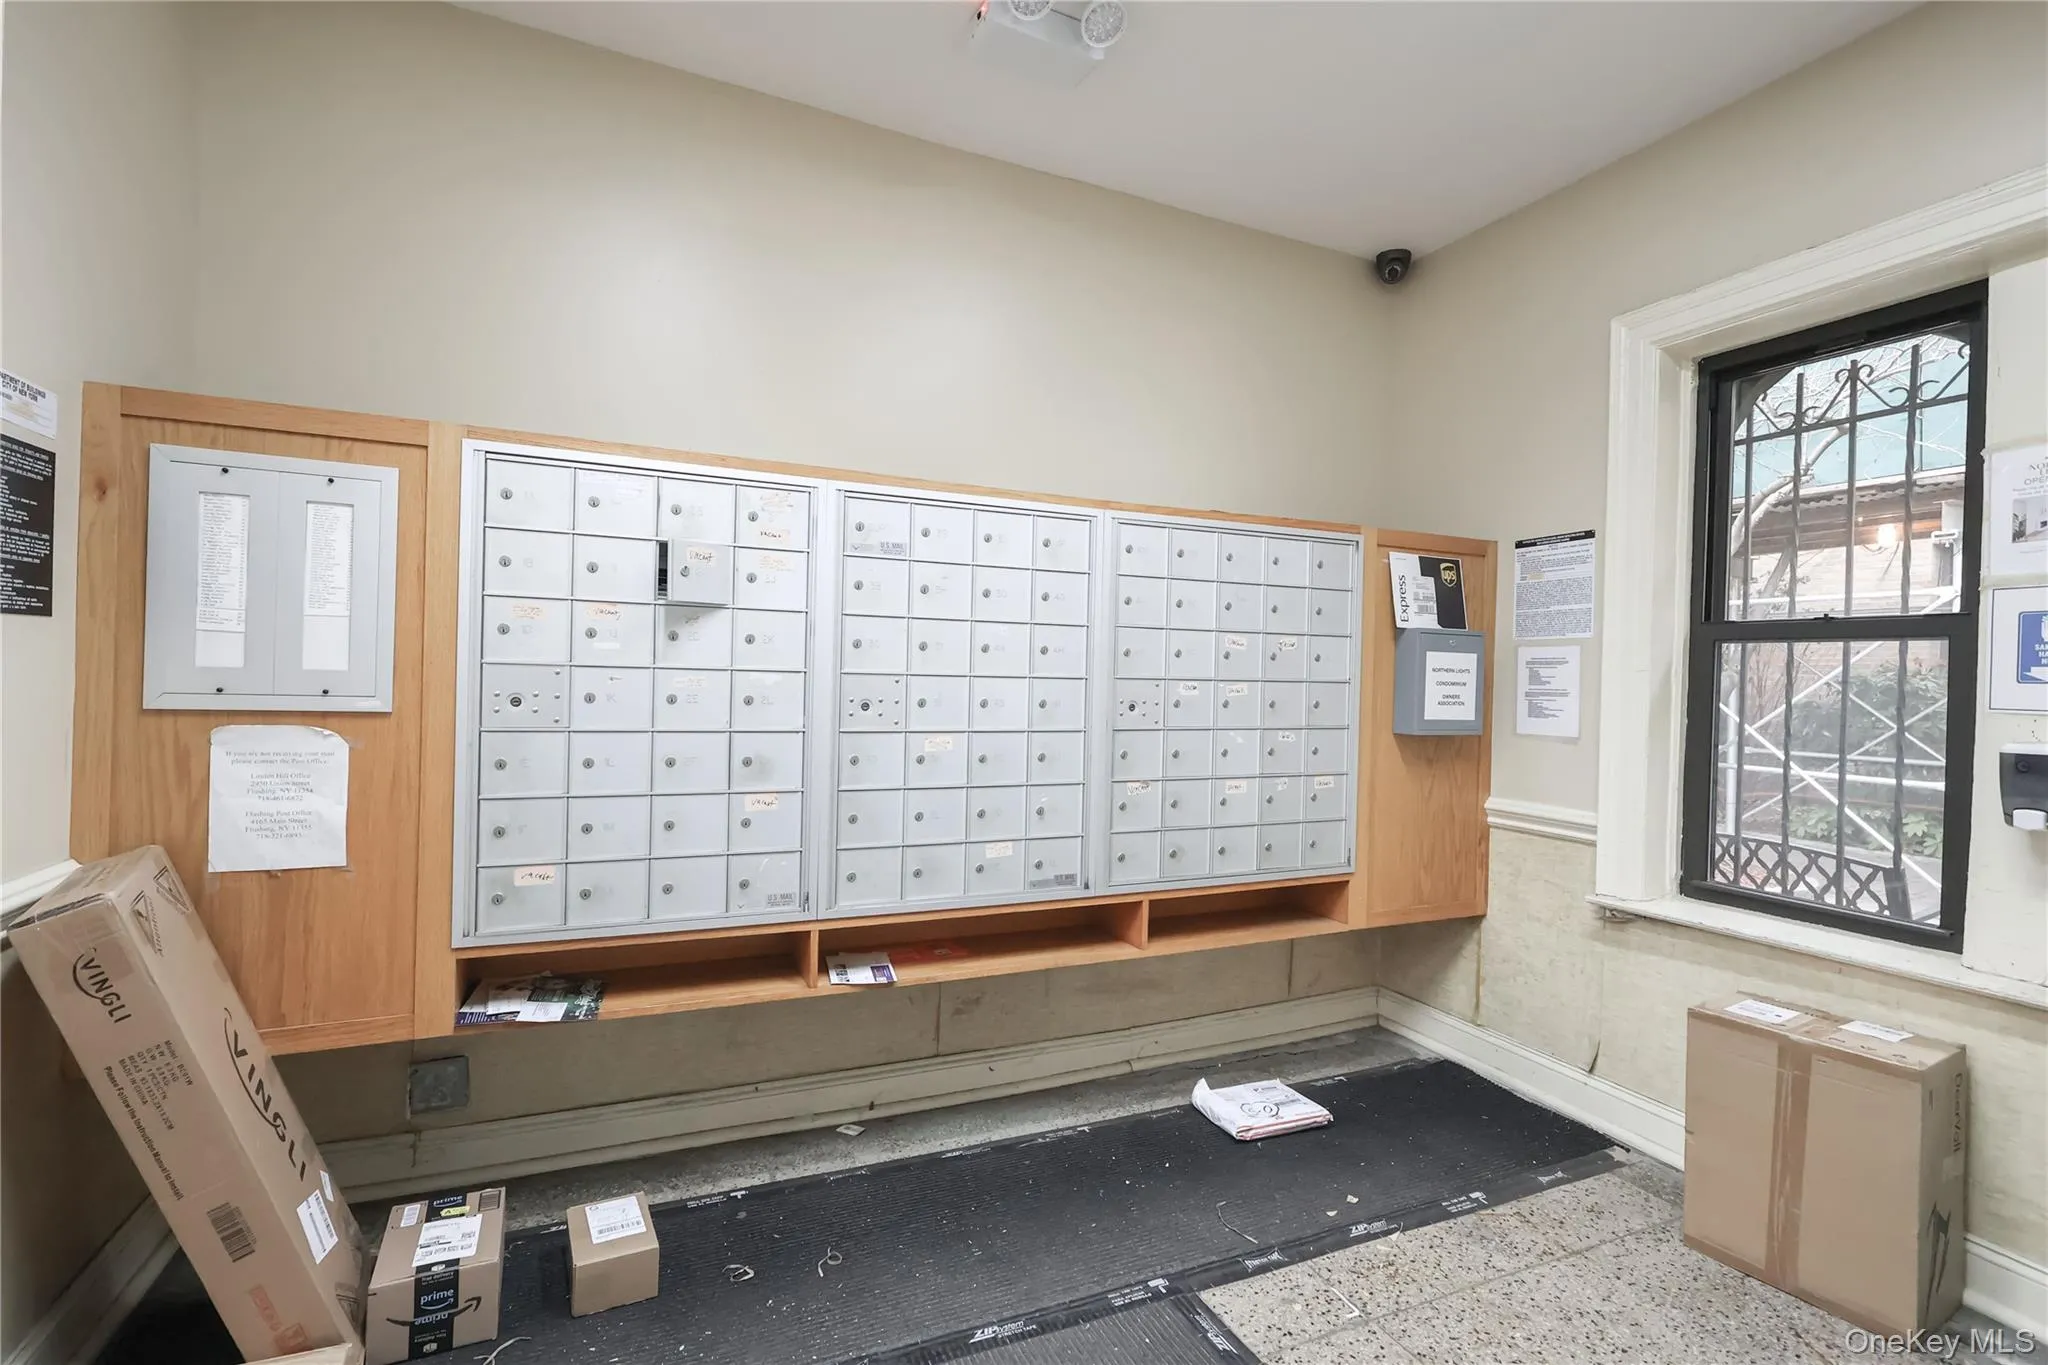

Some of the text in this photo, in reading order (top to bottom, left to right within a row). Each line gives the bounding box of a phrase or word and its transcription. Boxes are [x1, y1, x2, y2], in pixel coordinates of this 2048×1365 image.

[1399, 574, 1410, 622] Express
[80, 957, 132, 1023] VINGLI
[117, 1057, 133, 1078] MADE
[133, 1084, 149, 1106] CHINA
[234, 1030, 306, 1182] VINGLI
[103, 1064, 121, 1088] Please
[114, 1085, 133, 1110] Follow
[132, 1117, 157, 1153] Instruction
[151, 1150, 169, 1175] Manual
[434, 1195, 463, 1206] prime
[420, 1289, 454, 1305] prime
